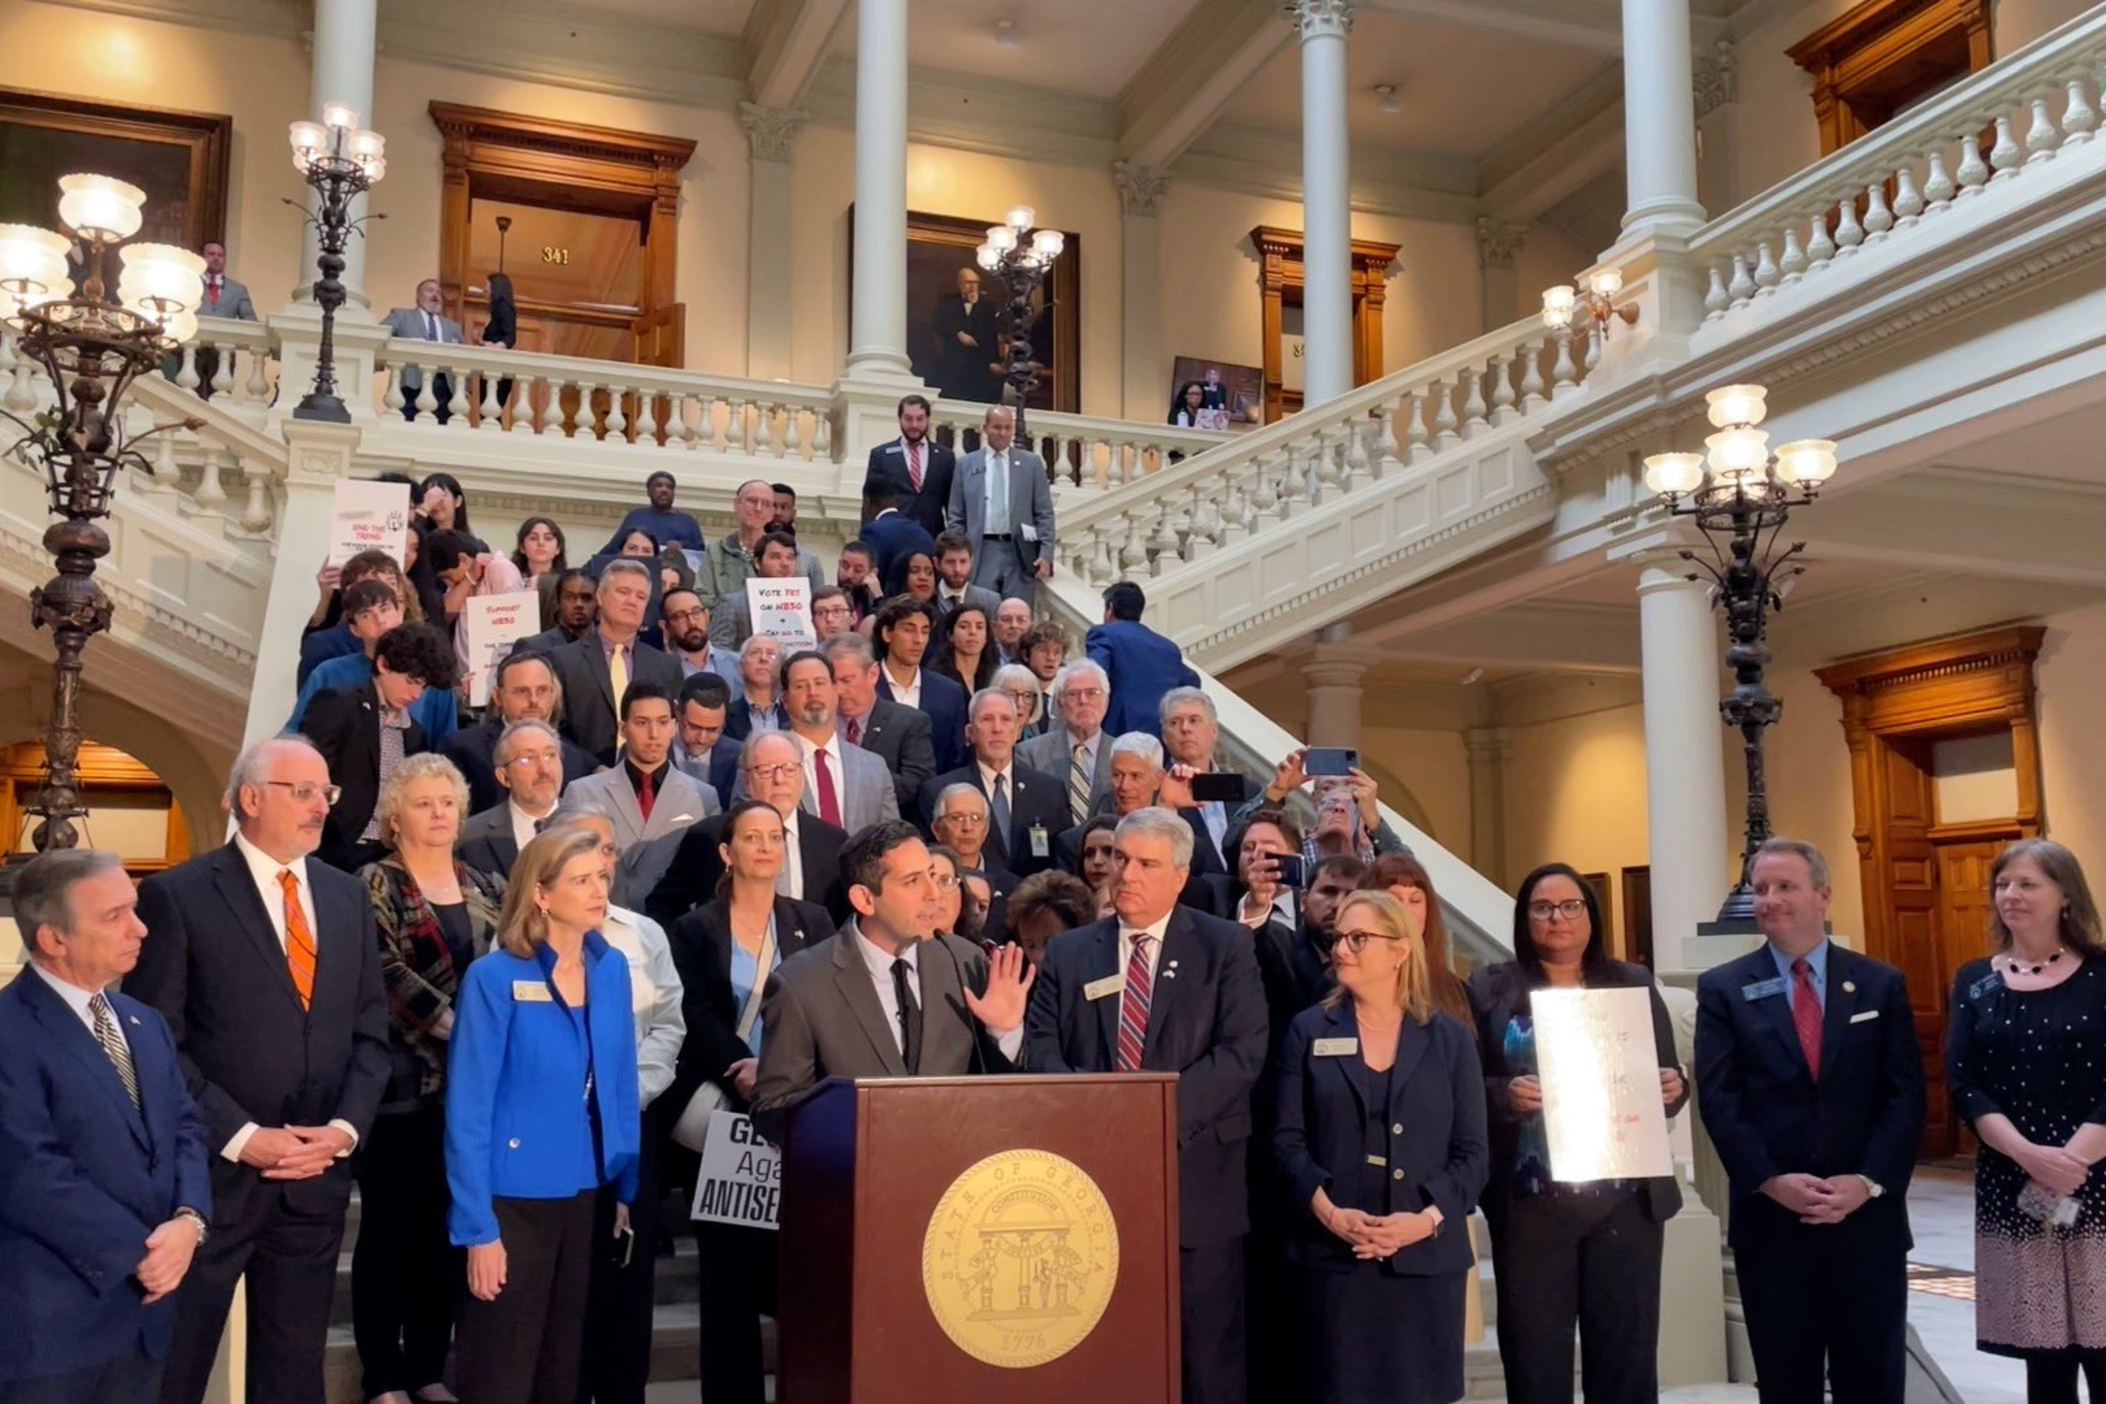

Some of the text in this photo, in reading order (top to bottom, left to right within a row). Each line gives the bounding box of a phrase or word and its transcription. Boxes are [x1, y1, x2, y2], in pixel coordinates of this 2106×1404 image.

[543, 246, 568, 265] 341
[759, 588, 801, 597] VOTE YES
[699, 1178, 780, 1224] ANTISE
[991, 1189, 1059, 1215] CONSTITUTION
[941, 1162, 1107, 1281] STATE OF GEORGIA
[1000, 1333, 1047, 1353] 1776
